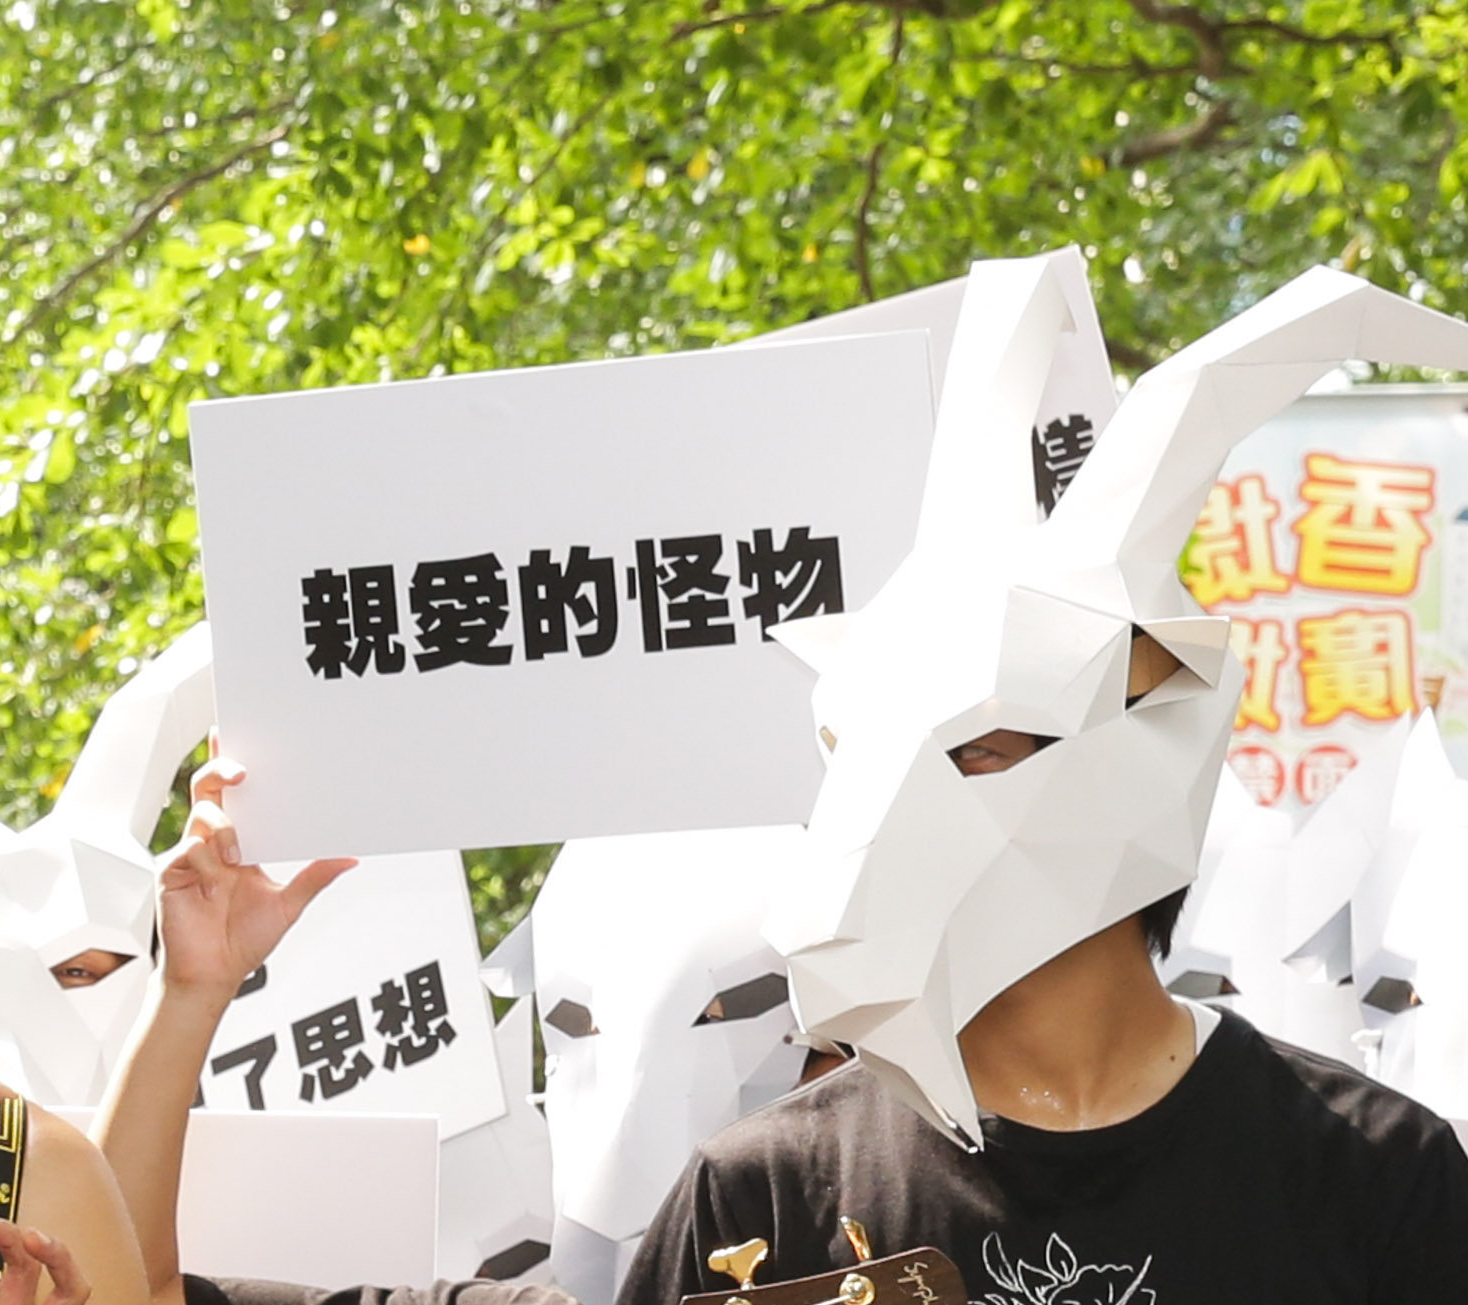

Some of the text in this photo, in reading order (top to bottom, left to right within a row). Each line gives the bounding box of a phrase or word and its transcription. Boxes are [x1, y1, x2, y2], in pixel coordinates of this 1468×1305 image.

[301, 526, 845, 680] 親愛的怪物
[191, 960, 457, 1110] 了思想
